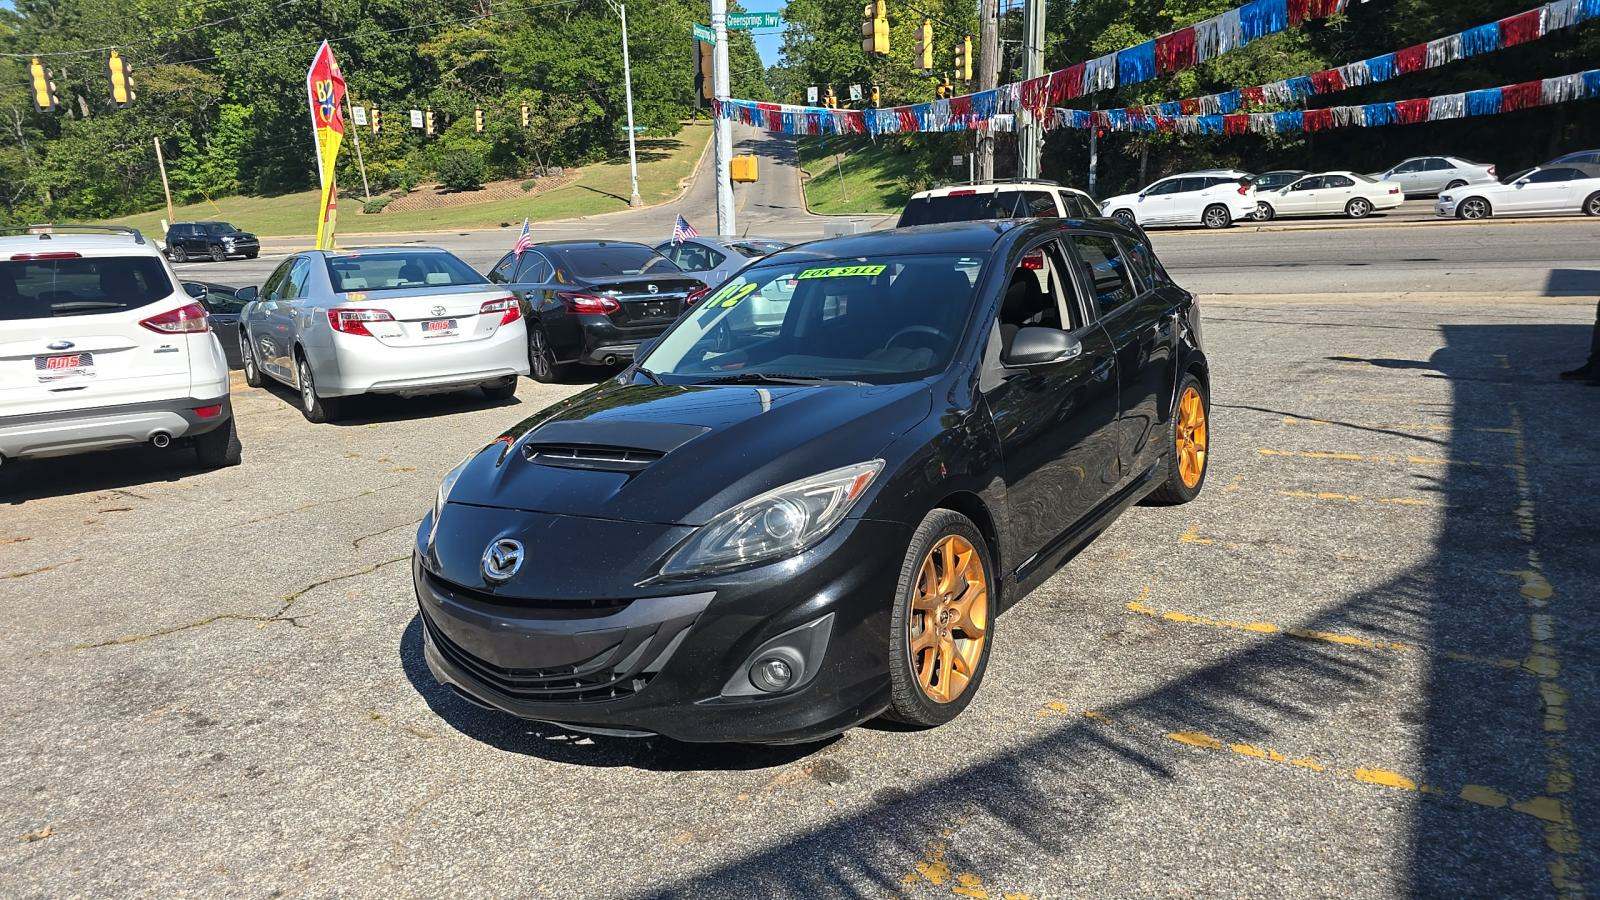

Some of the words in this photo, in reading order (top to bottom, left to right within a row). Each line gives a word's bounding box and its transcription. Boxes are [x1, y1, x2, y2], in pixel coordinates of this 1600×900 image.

[727, 15, 762, 27] Greensprings
[765, 14, 780, 27] Hwy
[801, 269, 834, 278] FOR
[838, 266, 884, 275] SALE
